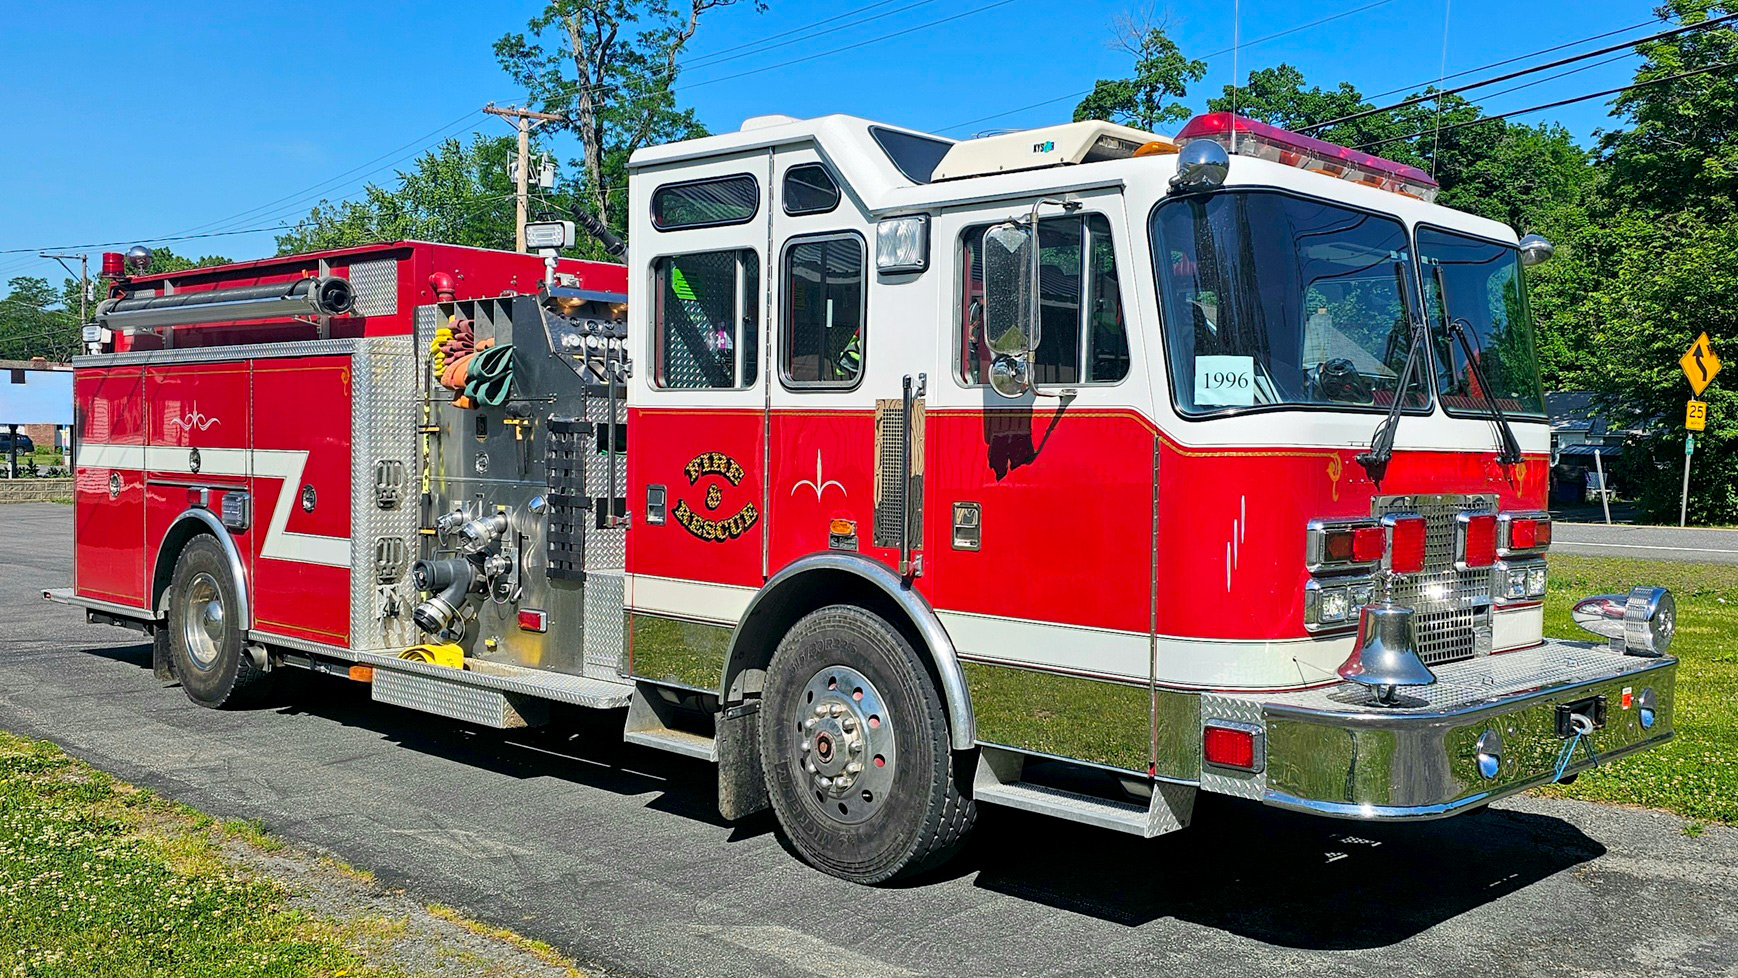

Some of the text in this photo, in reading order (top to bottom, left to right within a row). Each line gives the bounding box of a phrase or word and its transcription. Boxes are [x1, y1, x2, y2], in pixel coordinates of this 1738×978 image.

[1203, 371, 1249, 389] 1996
[1690, 405, 1704, 419] 25
[683, 451, 746, 487] FIRE
[704, 483, 723, 511] &
[671, 498, 759, 543] RESCUE
